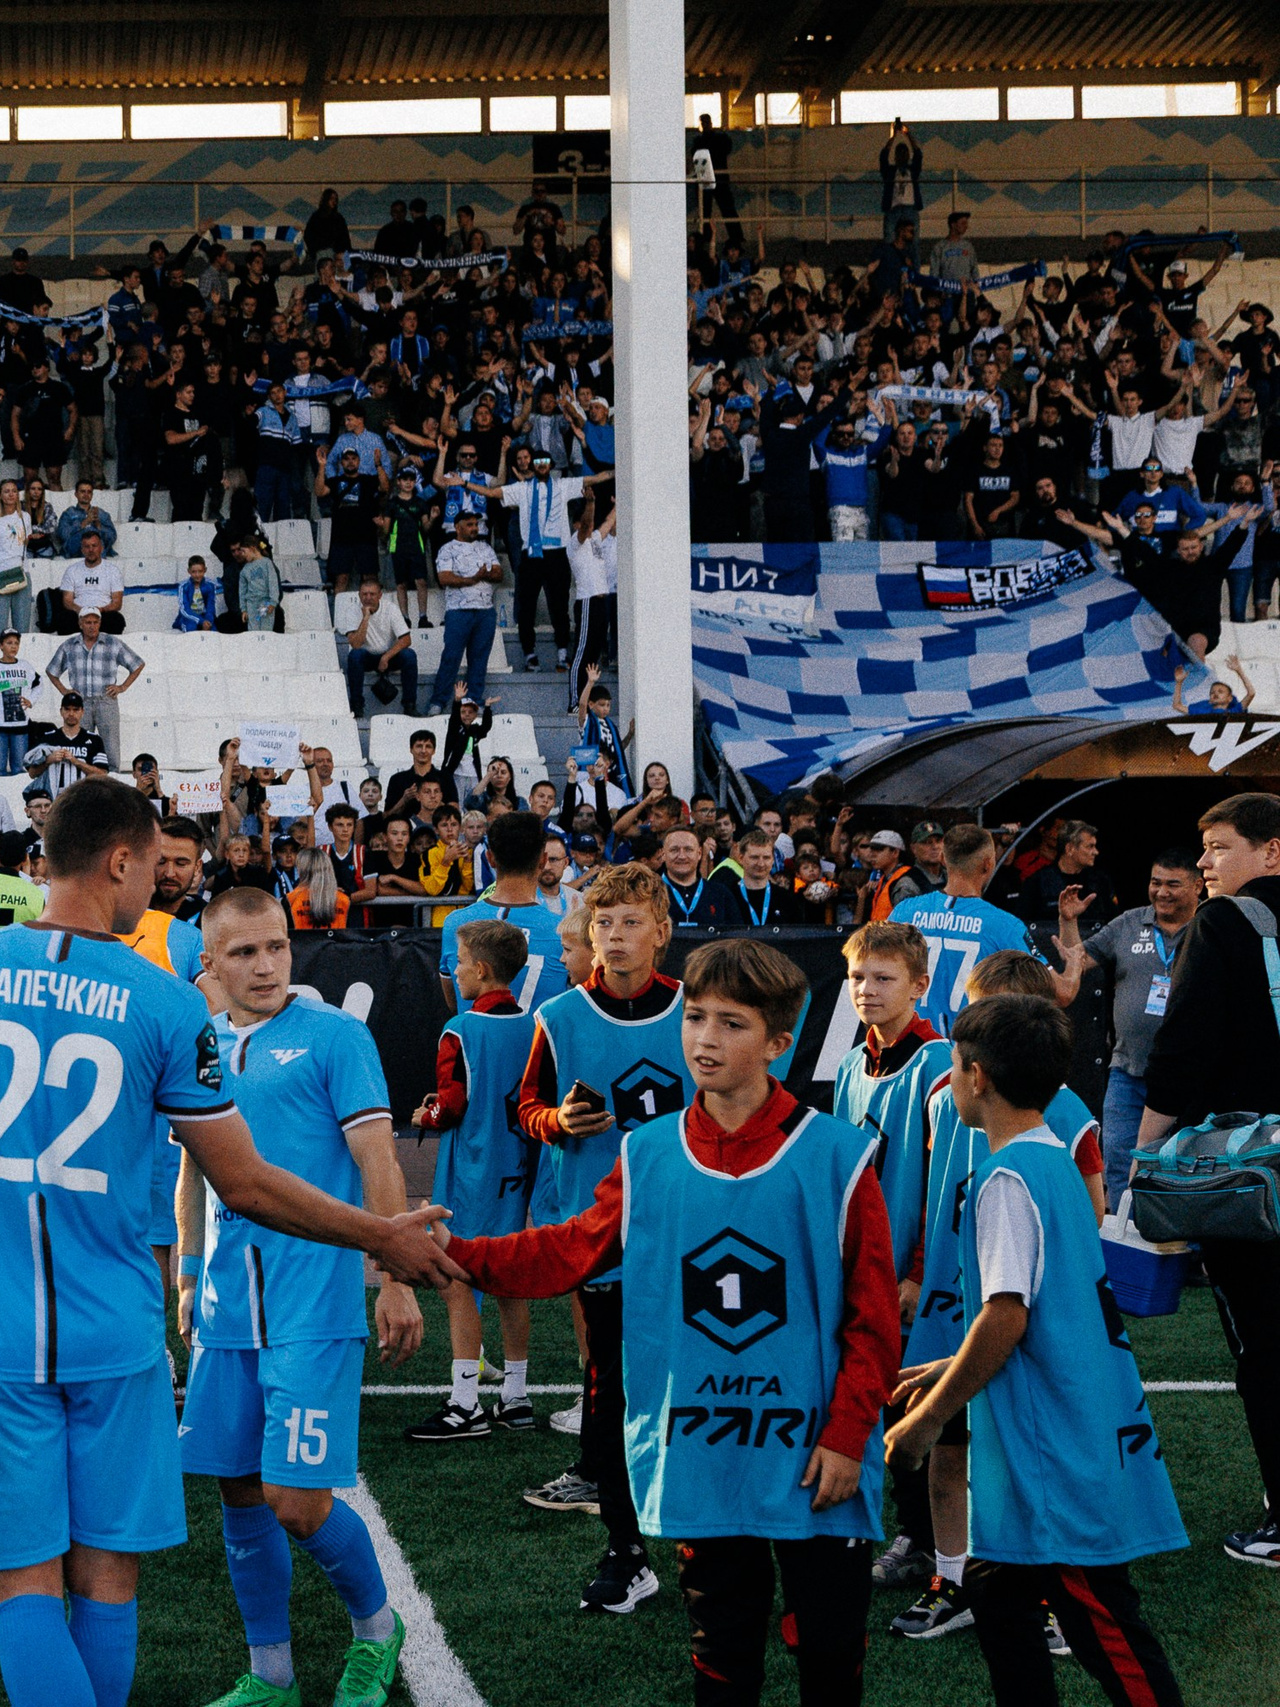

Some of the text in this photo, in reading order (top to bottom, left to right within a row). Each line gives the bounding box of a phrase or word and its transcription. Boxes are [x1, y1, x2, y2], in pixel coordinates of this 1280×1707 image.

[912, 911, 982, 934] САМОЙЛОВ
[639, 1089, 657, 1115] 1
[715, 1273, 741, 1310] 1
[695, 1374, 782, 1396] ЛИГА
[284, 1407, 329, 1466] 15
[666, 1406, 818, 1449] PARI
